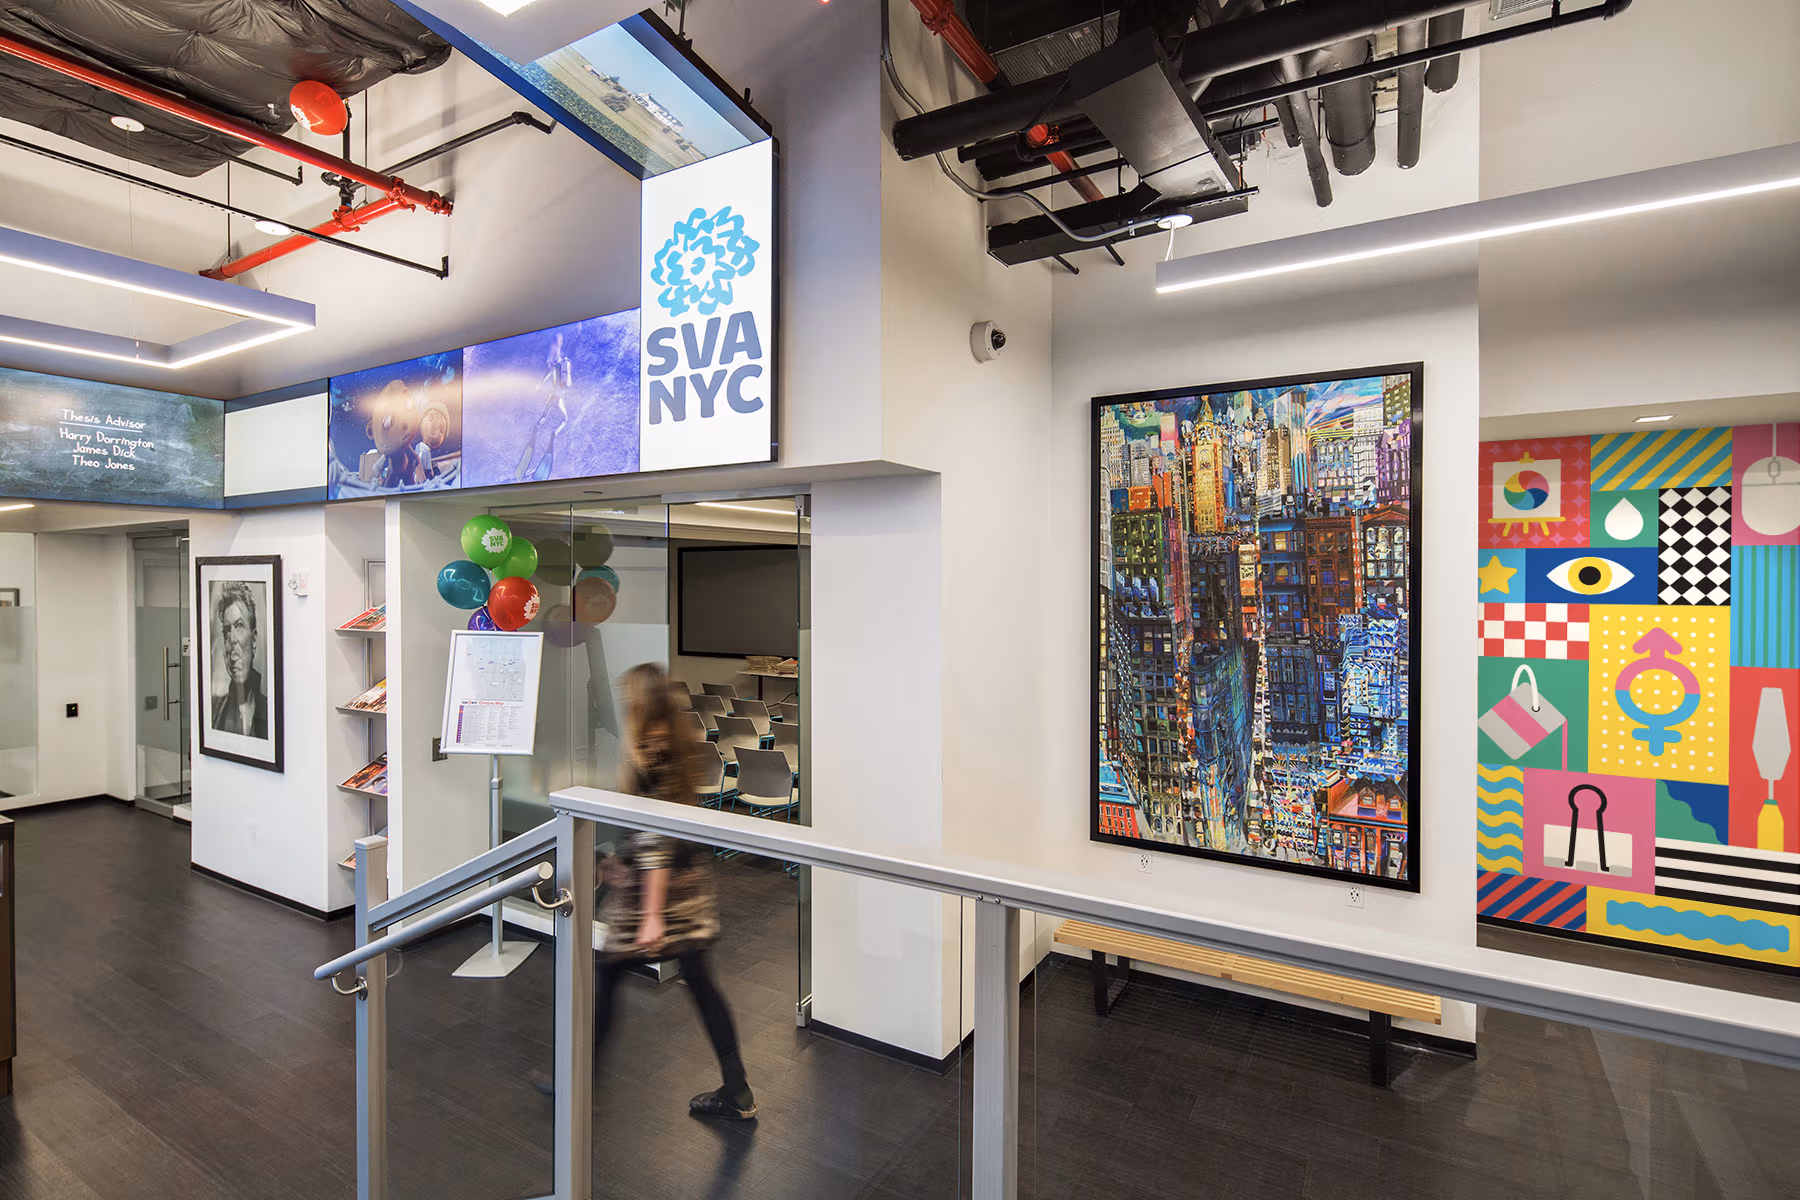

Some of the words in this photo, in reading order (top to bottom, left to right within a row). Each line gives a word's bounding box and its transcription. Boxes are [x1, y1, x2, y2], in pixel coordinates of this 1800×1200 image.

[646, 310, 763, 376] SVA
[648, 364, 764, 425] NYC
[62, 408, 101, 424] Thesis
[105, 414, 147, 430] Advisor
[59, 427, 92, 445] Harry
[96, 431, 154, 450] Dorrington
[72, 441, 109, 456] James
[112, 445, 136, 458] Dick
[72, 454, 100, 468] Theo
[104, 458, 136, 471] Jones
[490, 540, 504, 548] NYC
